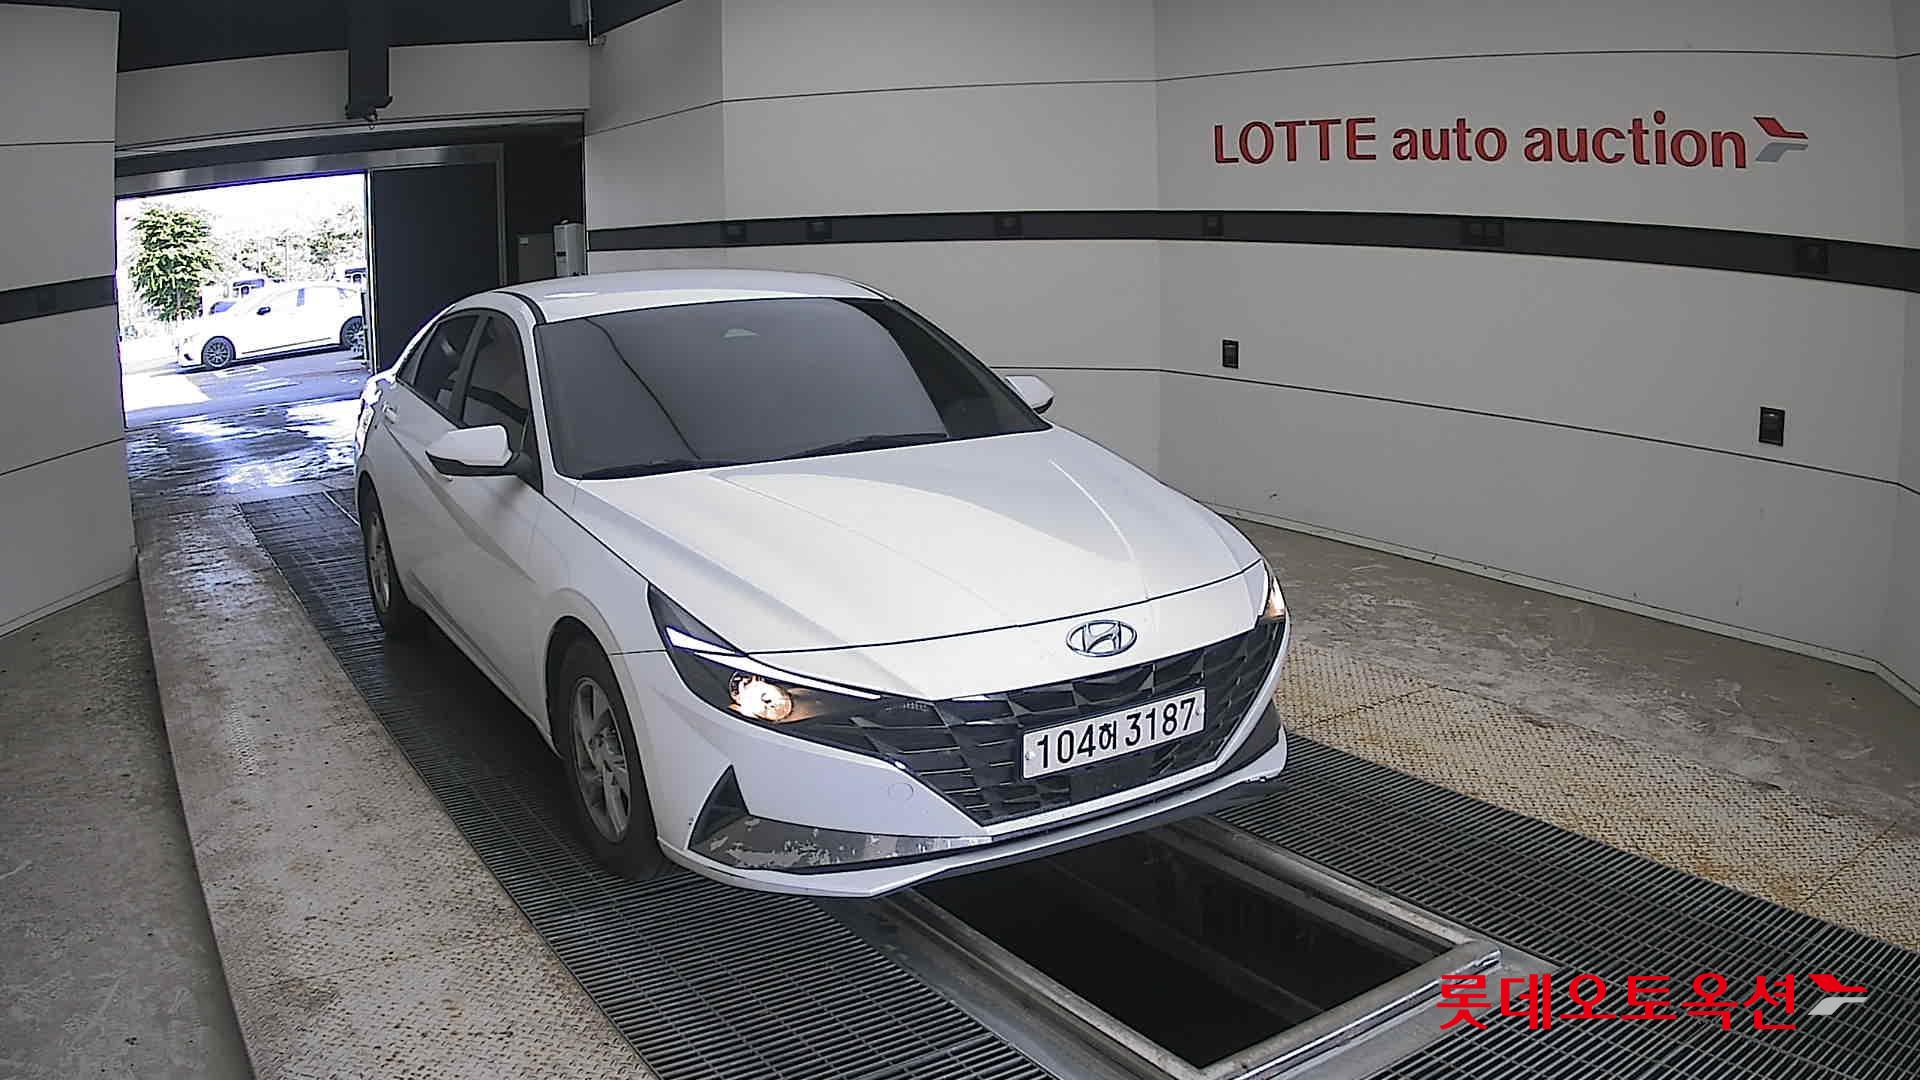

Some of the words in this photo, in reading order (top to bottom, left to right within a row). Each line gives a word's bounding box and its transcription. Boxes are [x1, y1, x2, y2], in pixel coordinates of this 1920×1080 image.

[1214, 117, 1376, 164] LOTTE
[1393, 118, 1507, 162] auto
[1523, 111, 1746, 168] auction
[1125, 698, 1196, 746] 3187
